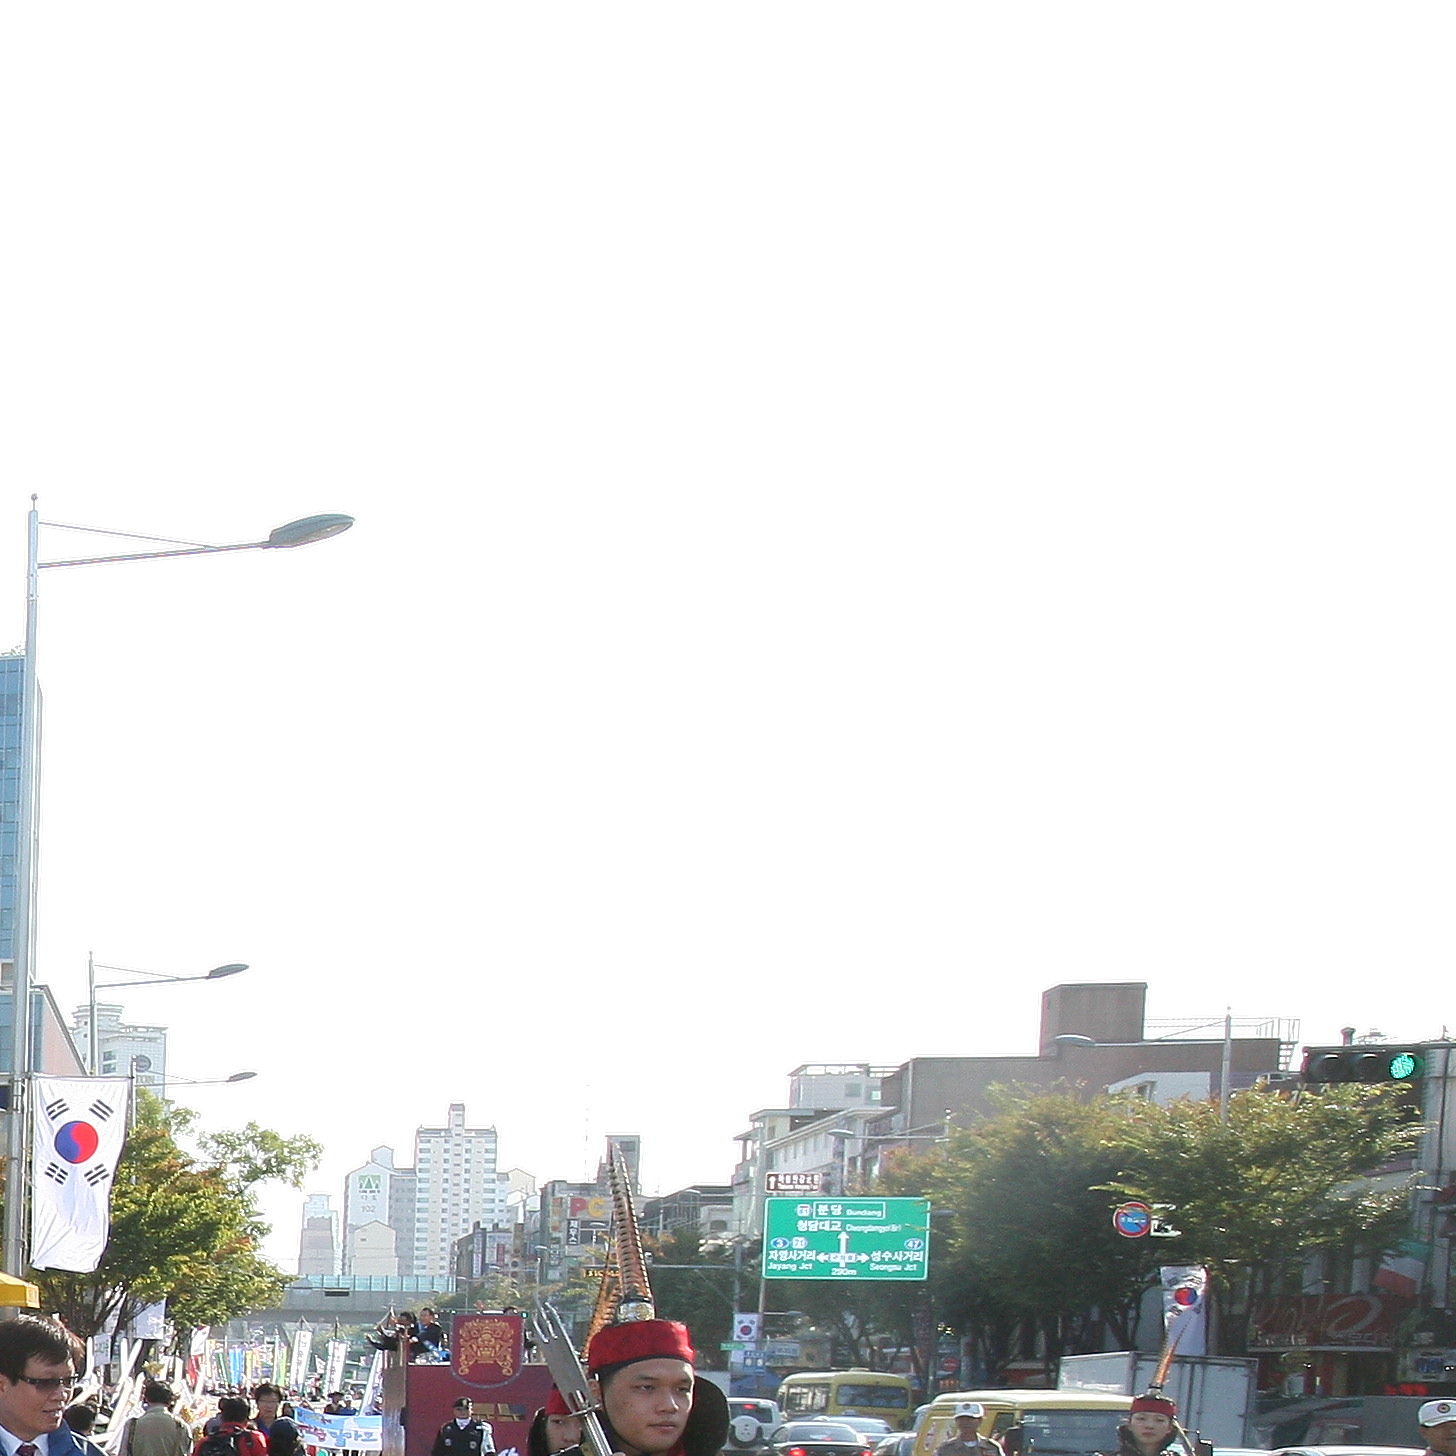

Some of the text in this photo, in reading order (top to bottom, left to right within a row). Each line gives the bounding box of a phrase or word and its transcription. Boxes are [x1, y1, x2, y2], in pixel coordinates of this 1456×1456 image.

[817, 1204, 843, 1216] 분당
[846, 1208, 882, 1218] Bundang
[796, 1220, 842, 1232] 청담대교
[907, 1240, 921, 1248] 47
[871, 1250, 924, 1262] 성수사거리
[768, 1261, 813, 1272] Jayang Jct
[904, 1263, 917, 1272] Jct
